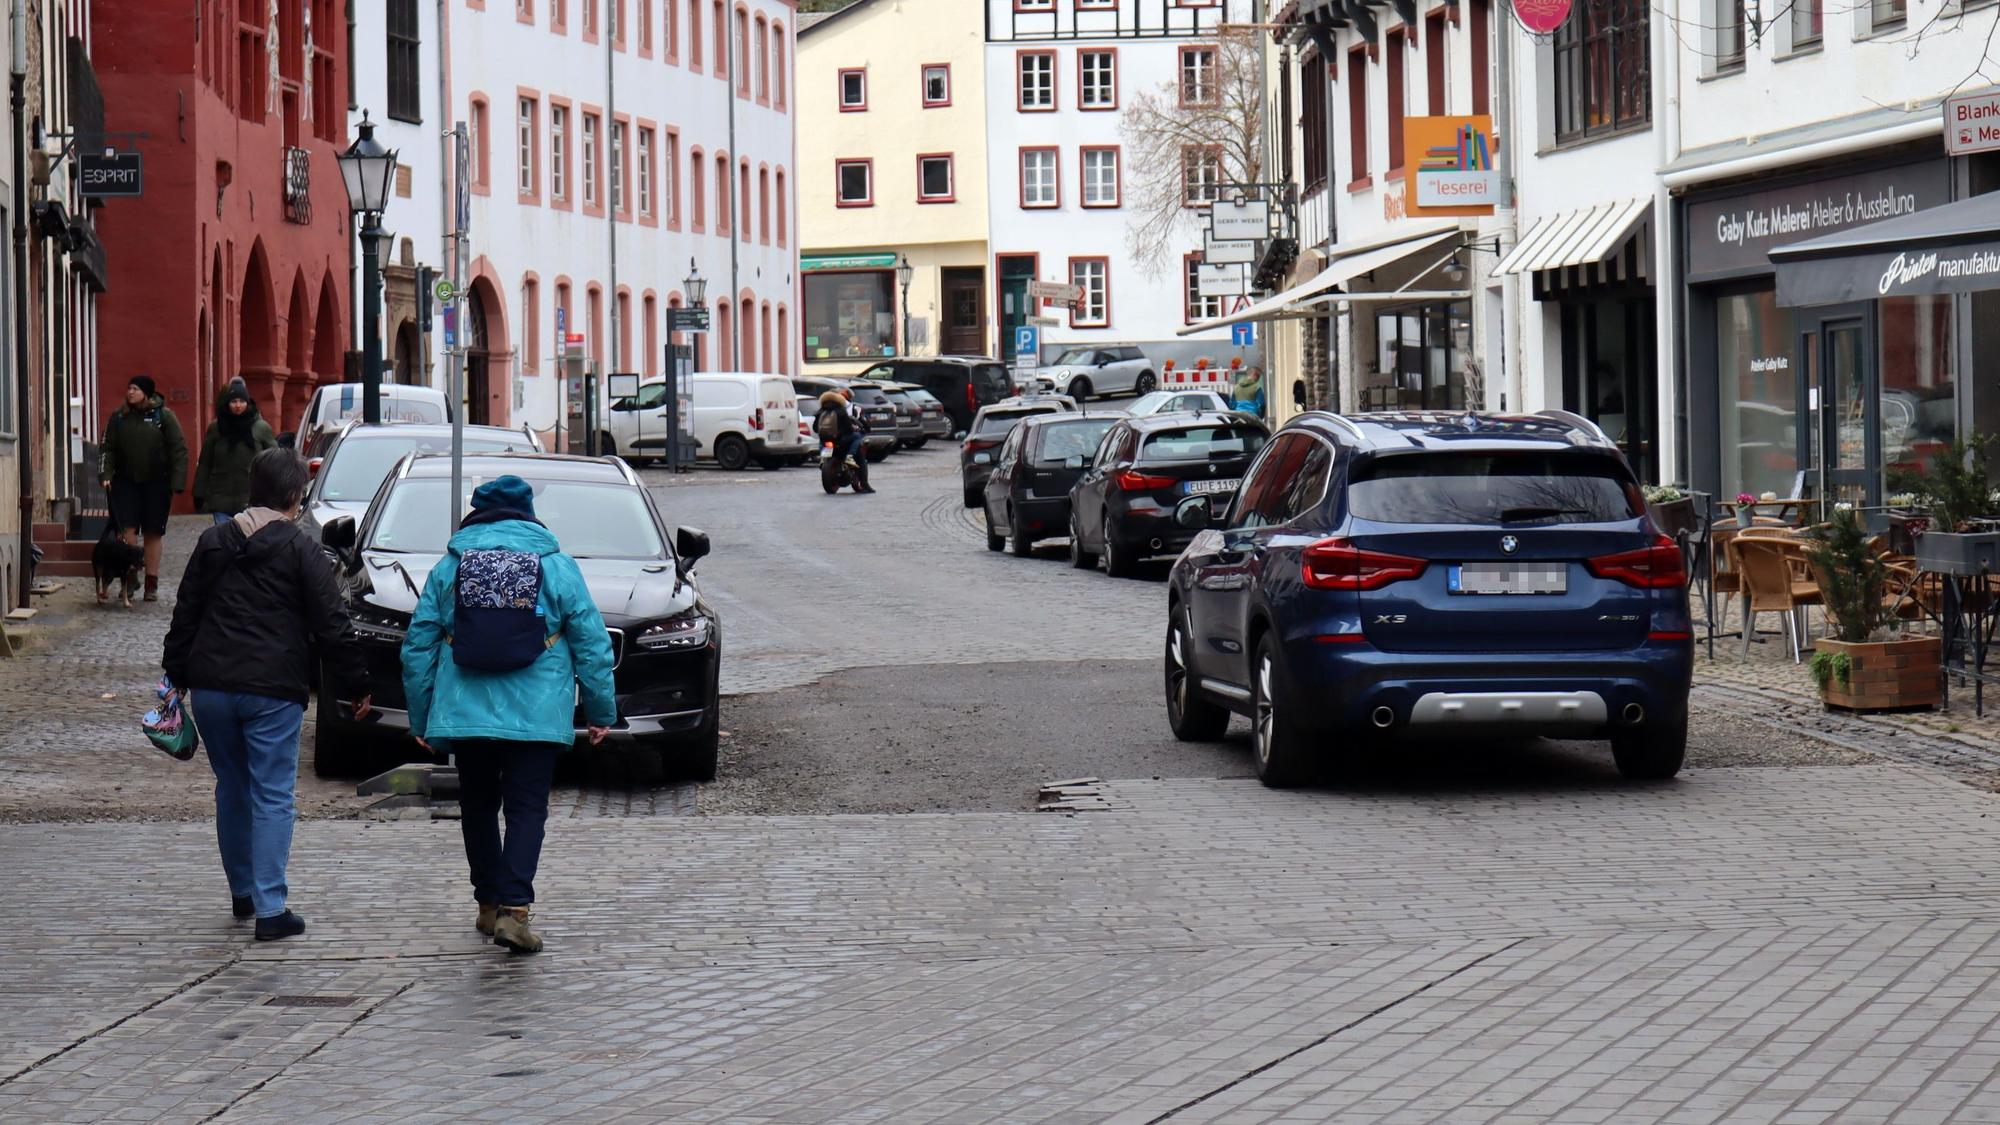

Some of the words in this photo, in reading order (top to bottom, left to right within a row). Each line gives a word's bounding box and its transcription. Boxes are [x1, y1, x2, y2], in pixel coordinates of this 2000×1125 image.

[84, 168, 137, 184] ESPRIT
[1437, 178, 1488, 195] leserei
[1240, 217, 1265, 225] WEBER
[1717, 212, 1745, 246] Gaby
[1746, 210, 1769, 239] Kutz
[1770, 203, 1811, 234] Malerei
[1811, 196, 1844, 229] Atelier
[1845, 192, 1854, 223] &
[1855, 185, 1915, 221] Ausstellung
[1878, 252, 1938, 294] Printen
[1373, 614, 1408, 624] X3
